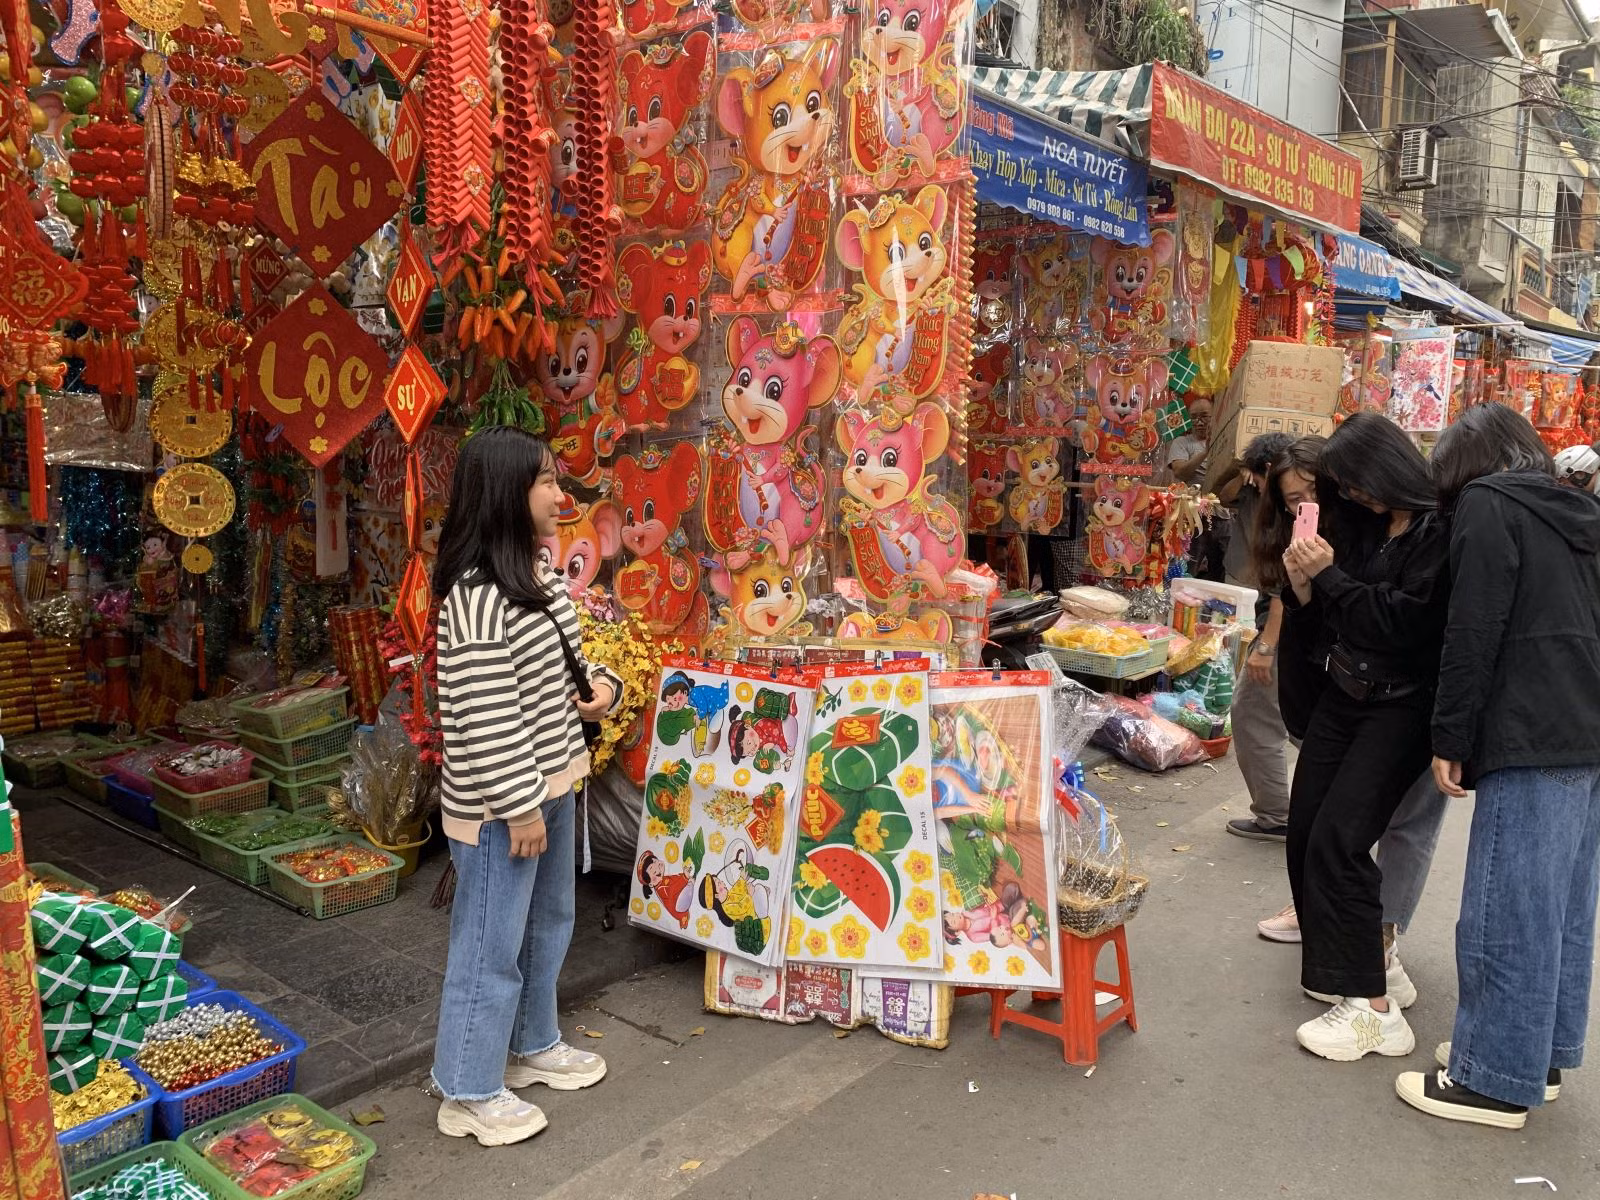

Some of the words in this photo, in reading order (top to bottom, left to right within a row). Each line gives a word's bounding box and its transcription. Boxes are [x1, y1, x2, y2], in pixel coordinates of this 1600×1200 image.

[396, 124, 413, 163] MỚI
[1042, 135, 1078, 168] NGA
[1083, 150, 1128, 185] TUYẾT
[1230, 117, 1256, 158] 22A
[1266, 132, 1284, 169] SƯ
[252, 135, 371, 236] Tài
[969, 138, 994, 179] Khay
[995, 149, 1017, 187] Hộp
[1018, 156, 1038, 194] Xốp
[1045, 166, 1066, 198] Mica
[1103, 185, 1124, 223] Rồng
[1243, 163, 1272, 196] 0982
[1274, 176, 1294, 205] 835
[1297, 185, 1315, 212] 133
[1027, 197, 1046, 214] 0979
[1047, 203, 1061, 218] 808
[1083, 214, 1100, 230] 0982
[396, 274, 417, 309] VẠN
[258, 331, 373, 429] Lộc
[397, 379, 416, 417] SỰ
[649, 755, 657, 770] DECAL
